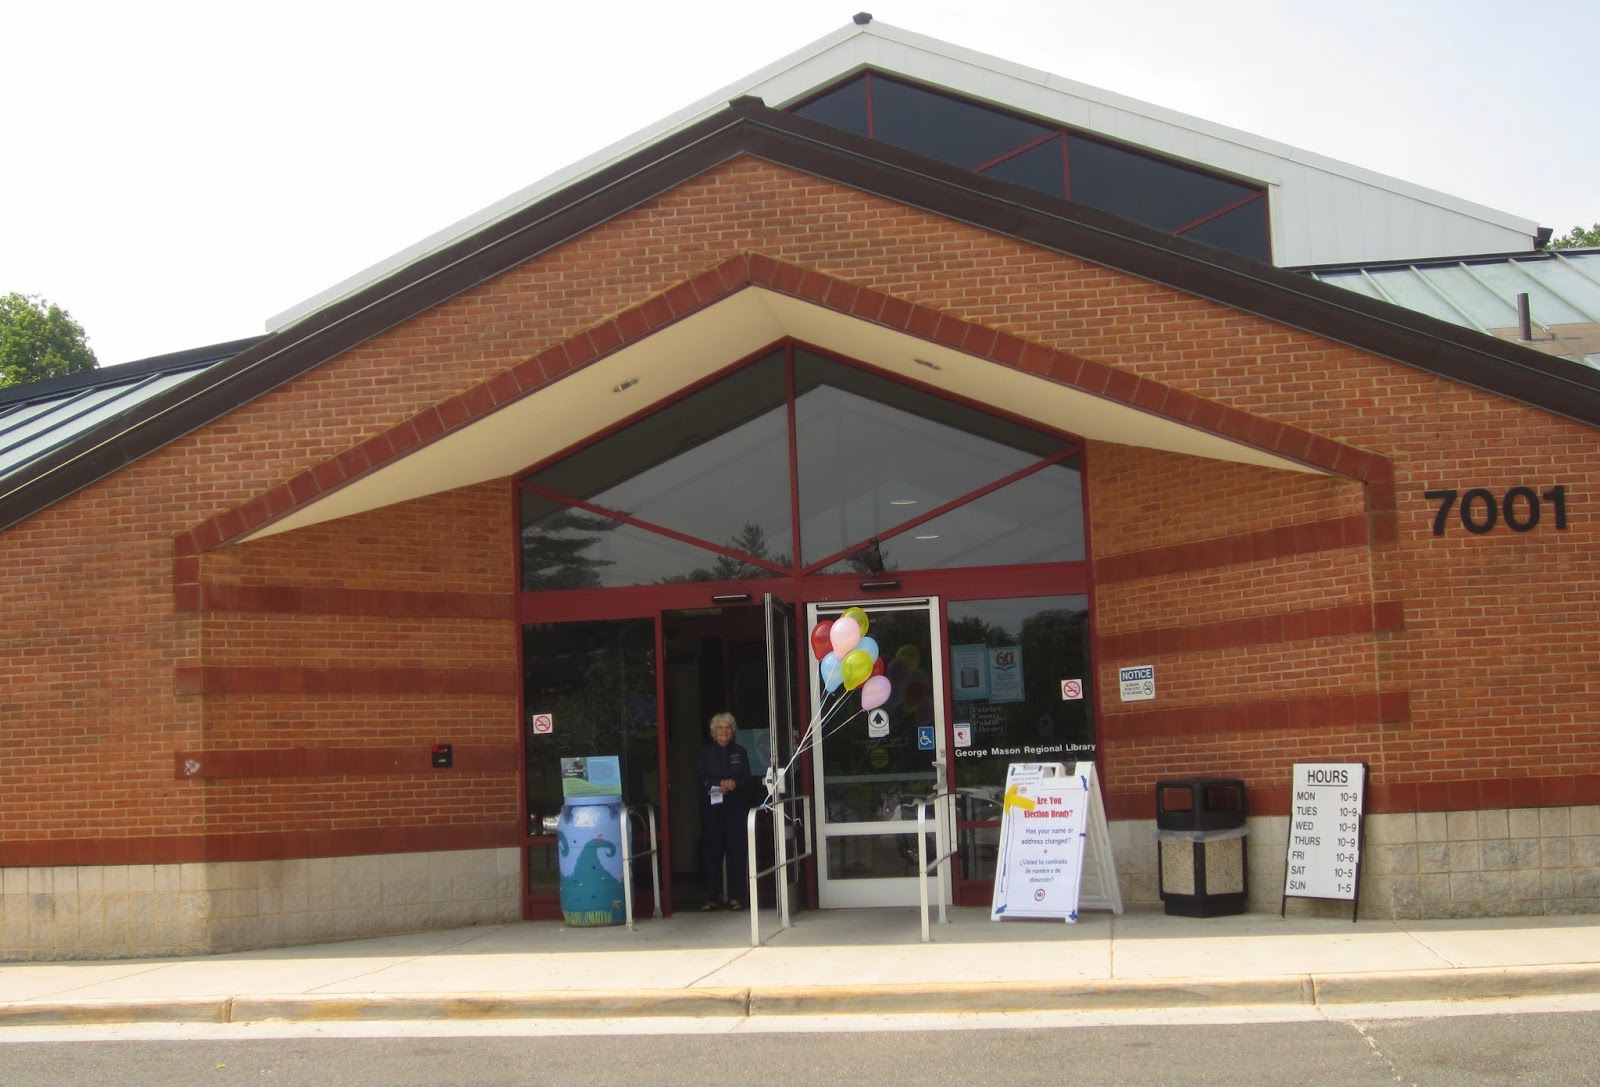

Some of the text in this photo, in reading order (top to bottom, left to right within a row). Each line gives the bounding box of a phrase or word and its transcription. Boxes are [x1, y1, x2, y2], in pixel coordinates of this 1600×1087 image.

[1425, 485, 1567, 536] 7001
[1122, 669, 1151, 680] NOTICE
[955, 749, 988, 757] George
[1024, 745, 1062, 754] Regional
[1066, 744, 1096, 752] Library
[1307, 770, 1348, 784] HOURS
[1037, 796, 1062, 805] Are You
[1297, 792, 1358, 802] MON 10-9
[1024, 810, 1073, 818] Election Ready?
[1297, 807, 1357, 817] TUES 10-9
[1295, 822, 1356, 832] WED 10-9
[1044, 838, 1071, 846] changed?
[1294, 837, 1355, 847] THURS 10-9
[1292, 851, 1354, 862] FRI 10-6
[1291, 866, 1353, 877] SAT 10-5
[1289, 881, 1352, 892] SUN 1-5
